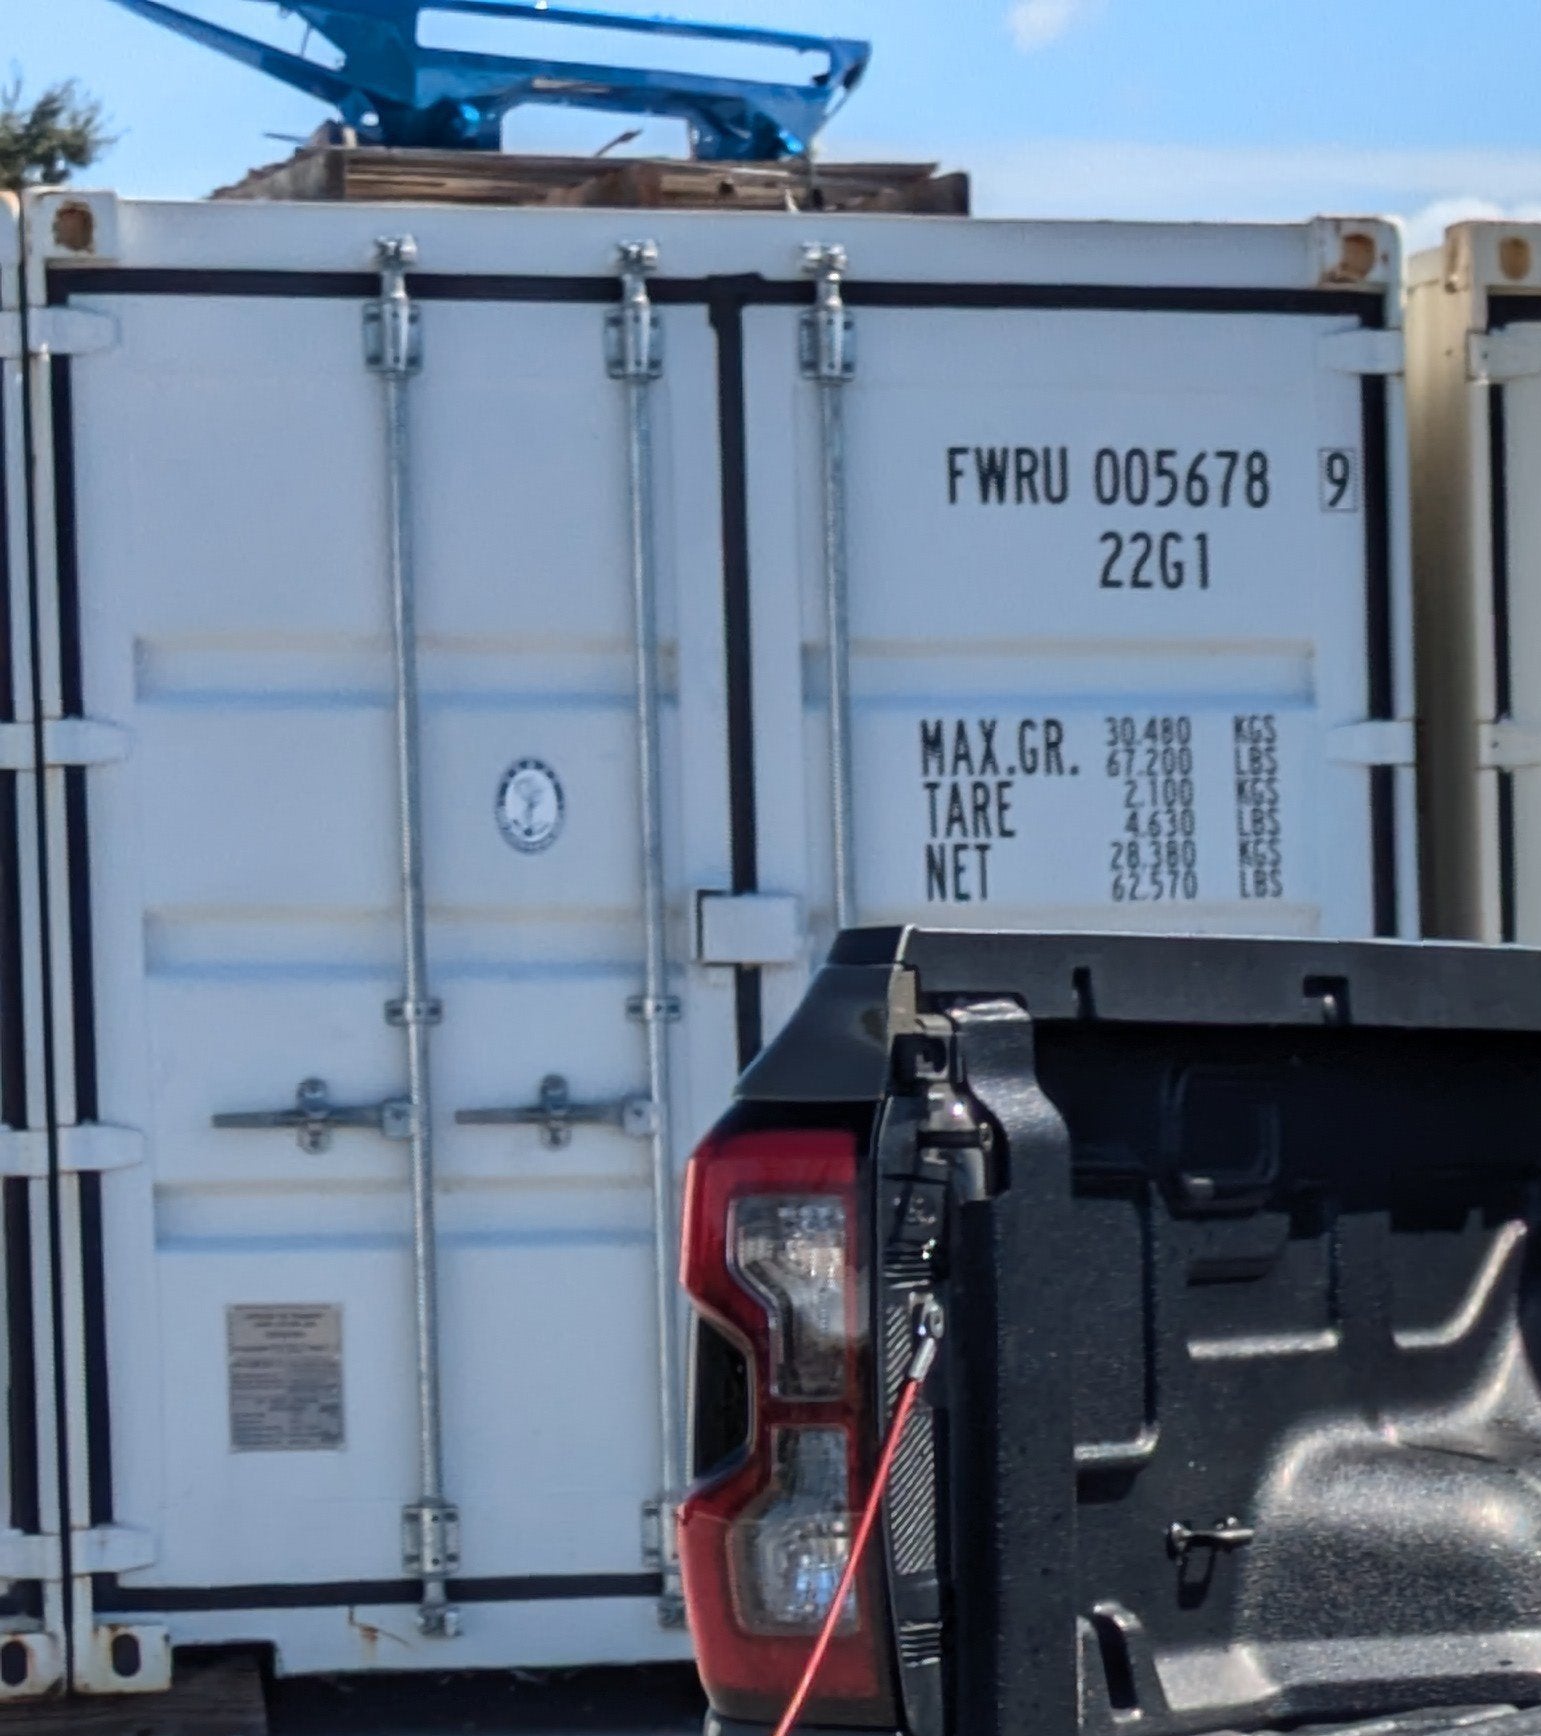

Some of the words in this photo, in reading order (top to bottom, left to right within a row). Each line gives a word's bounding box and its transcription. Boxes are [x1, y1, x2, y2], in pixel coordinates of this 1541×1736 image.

[946, 447, 1069, 504] FWRU
[1094, 448, 1270, 508] 005678
[1325, 451, 1350, 507] 9
[1099, 531, 1210, 589] 22G1
[920, 718, 1080, 777] MAX.GR.
[1233, 714, 1277, 744] KGS
[1234, 745, 1278, 776] LBS
[923, 780, 1017, 838] TARE
[1236, 777, 1279, 805] KGS
[1237, 808, 1281, 836] LBS
[925, 842, 991, 902] NET
[1239, 838, 1282, 867] KGS
[1239, 869, 1283, 898] LBS
